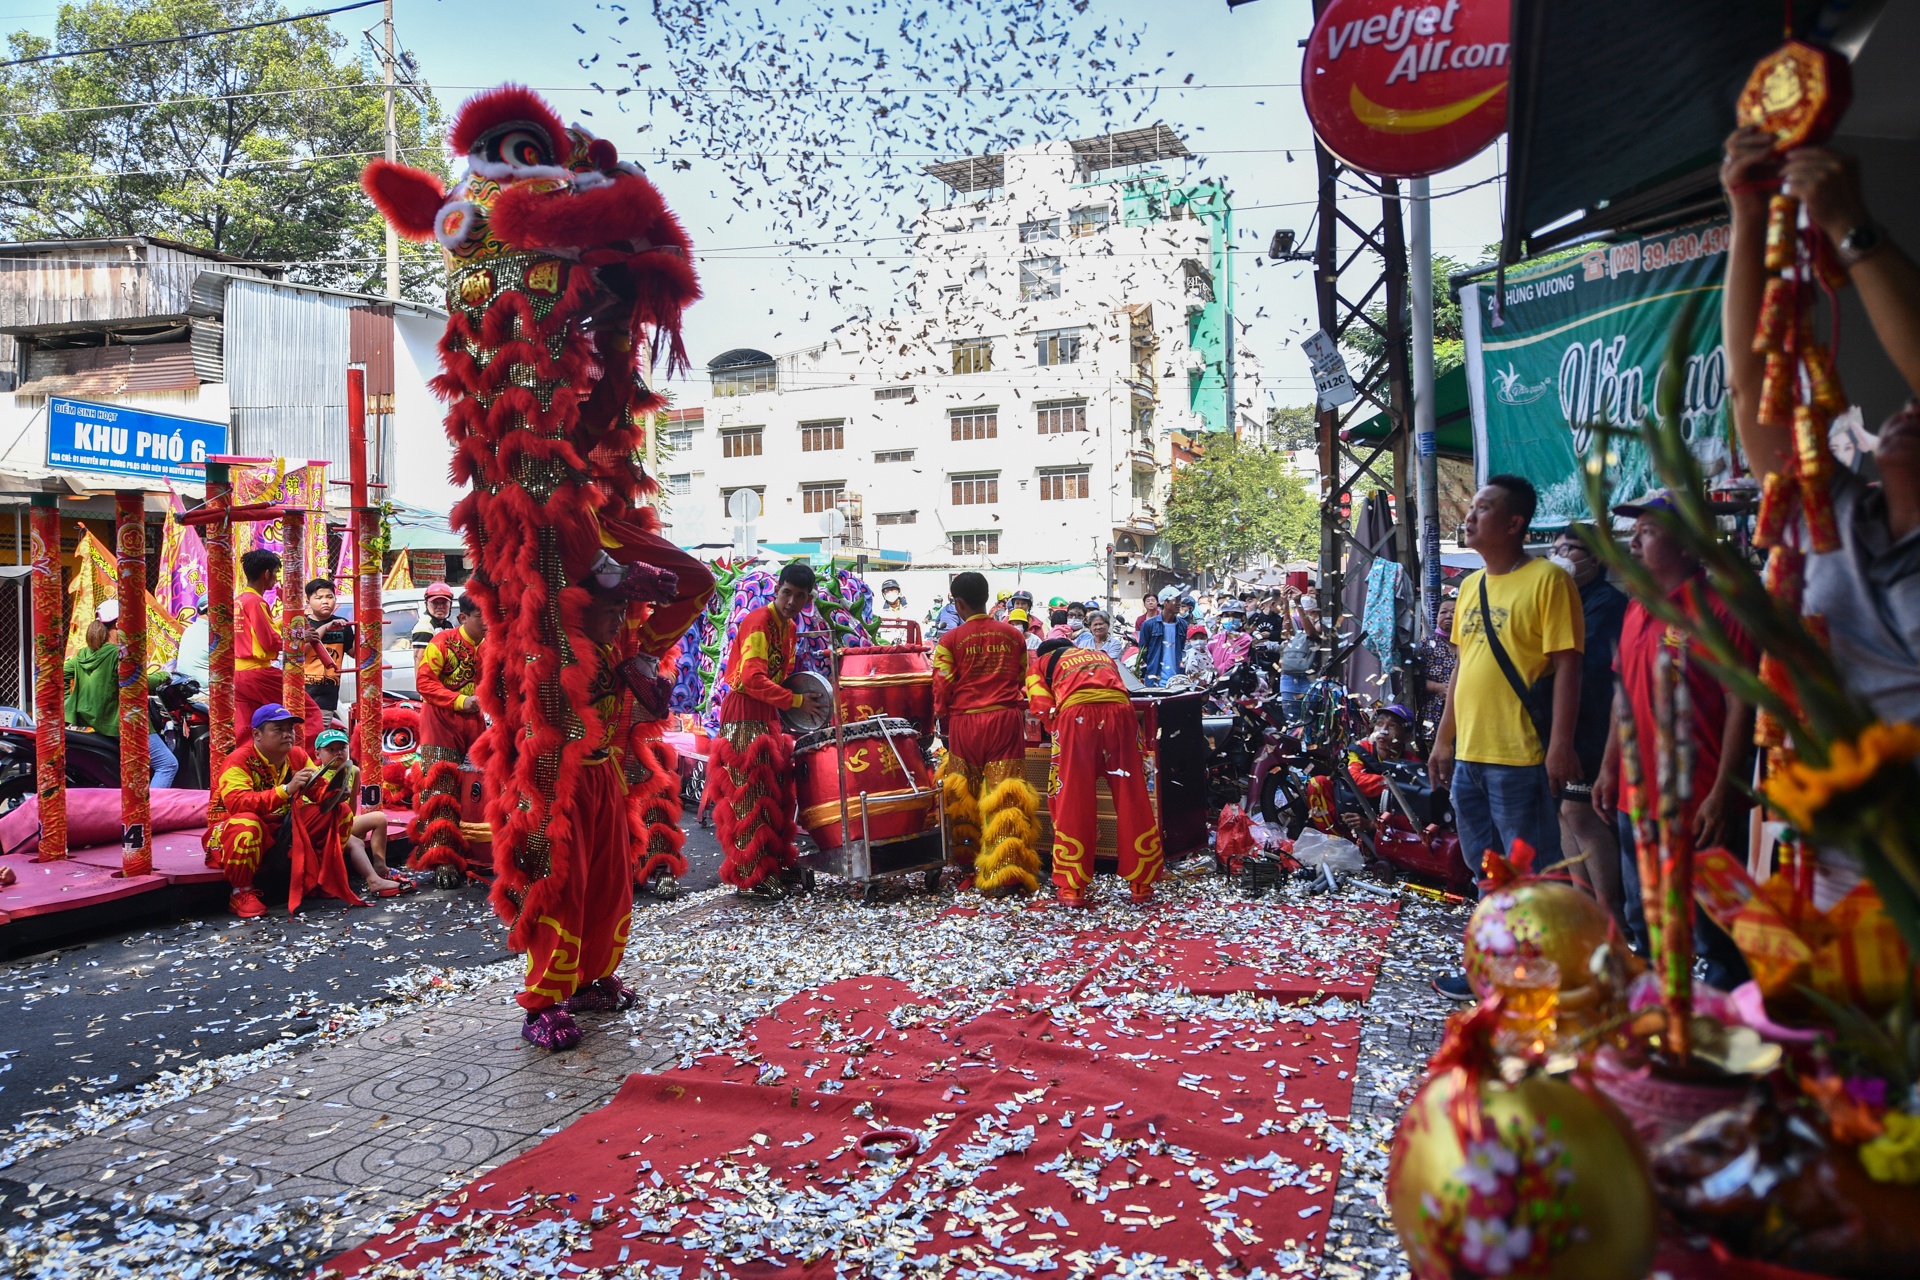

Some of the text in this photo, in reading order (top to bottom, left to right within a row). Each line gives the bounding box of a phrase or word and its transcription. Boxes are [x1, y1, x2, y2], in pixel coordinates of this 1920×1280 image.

[1505, 284, 1534, 306] HÙNG
[1535, 274, 1575, 298] VƯƠNG
[1319, 374, 1346, 392] H12C
[1558, 334, 1648, 459] Yến
[54, 402, 118, 422] ĐIỂM SINH HOẠT
[74, 421, 206, 463] KHU PHỐ 6
[1060, 653, 1112, 670] DIMSUM
